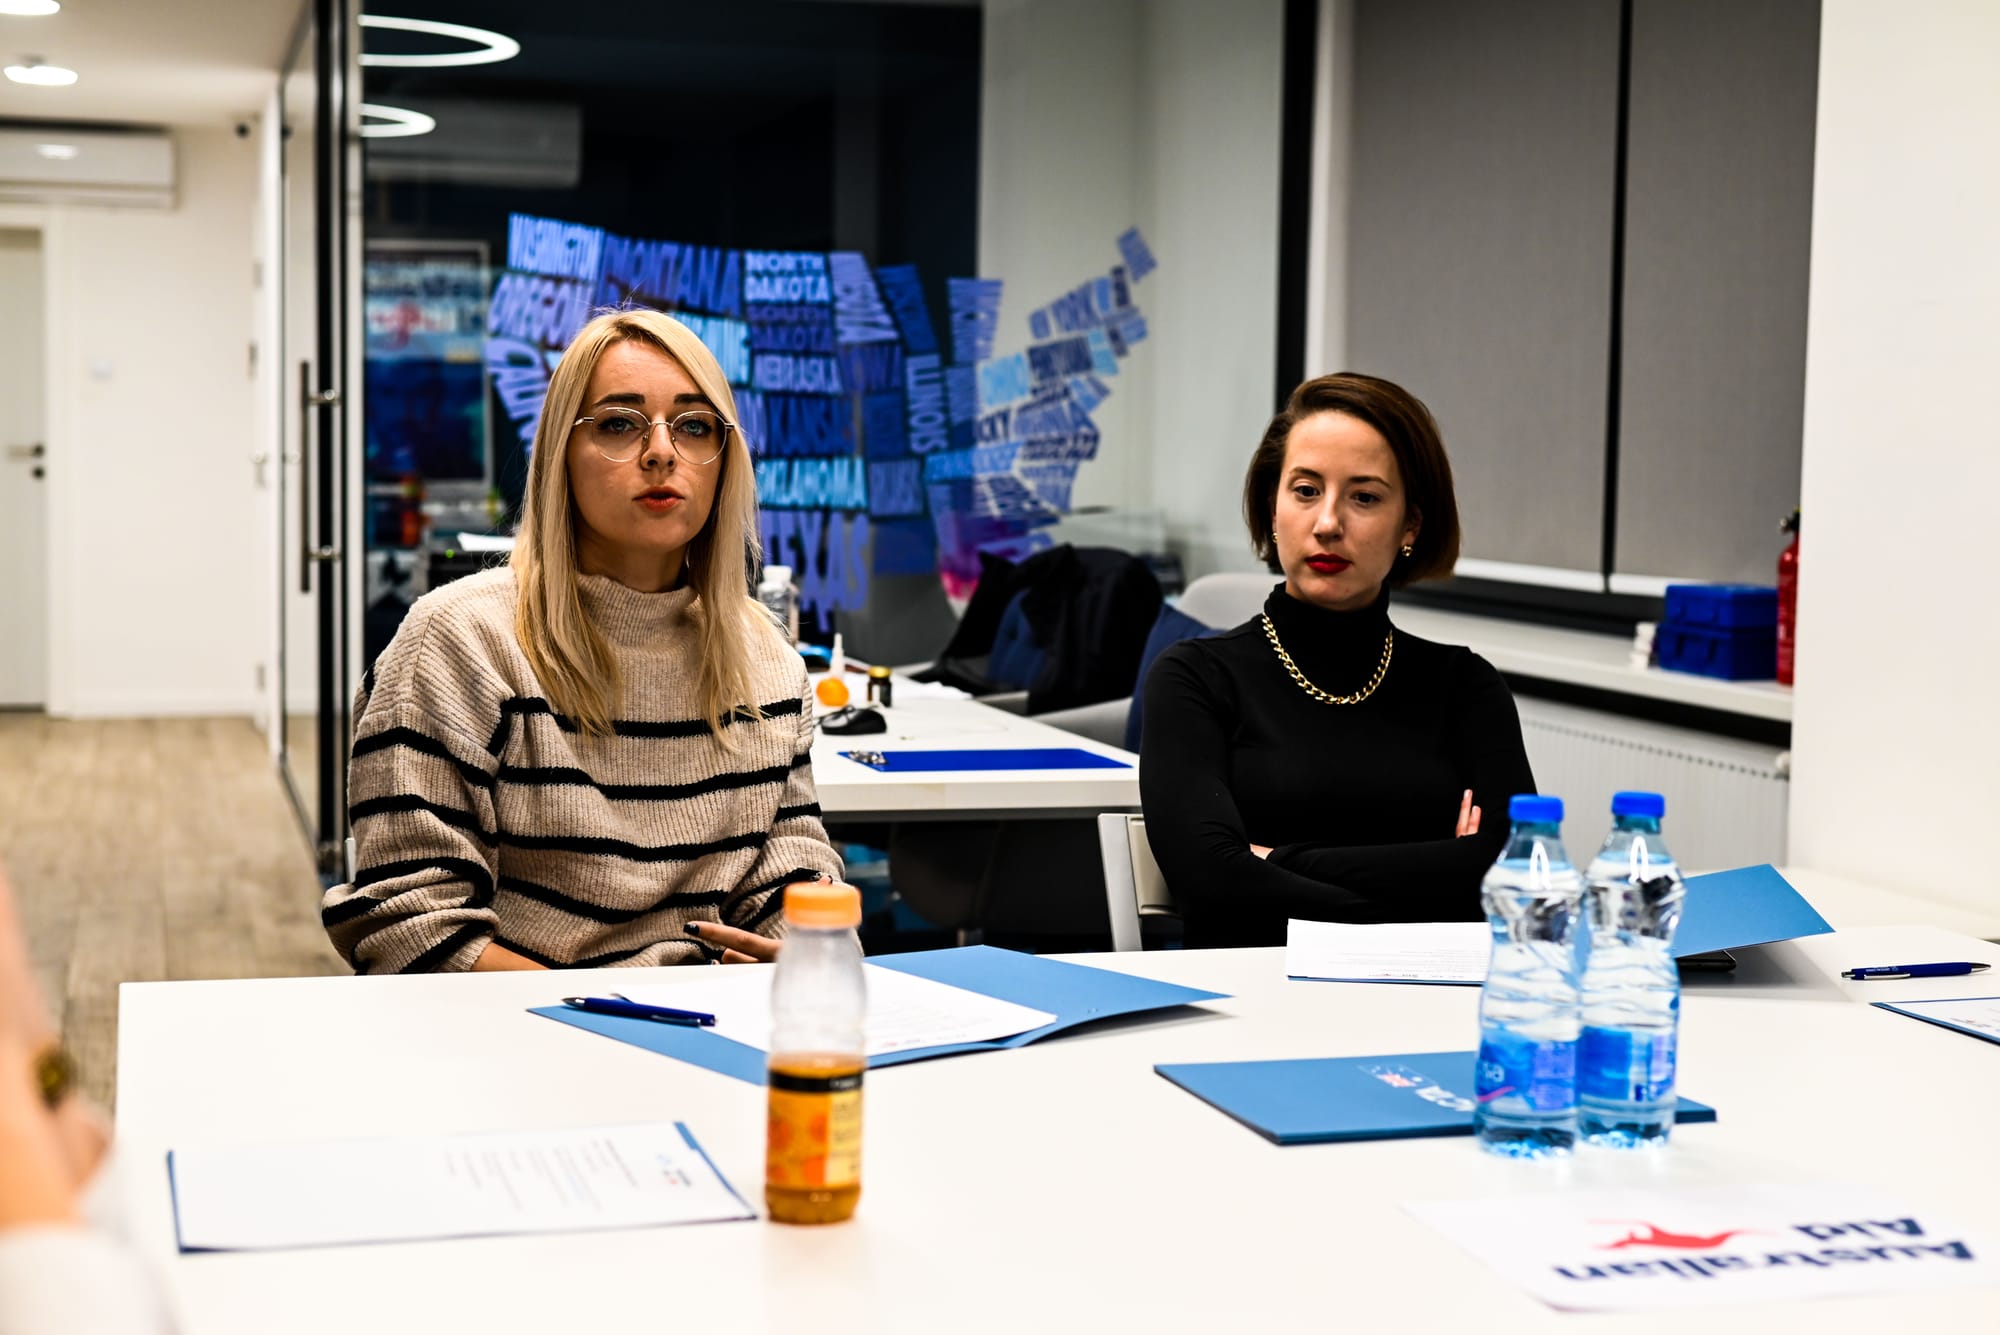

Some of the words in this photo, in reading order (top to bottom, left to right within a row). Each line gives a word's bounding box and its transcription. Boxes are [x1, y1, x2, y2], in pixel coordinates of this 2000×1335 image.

[508, 212, 604, 283] WASHINGTON
[745, 252, 825, 271] NORTH
[599, 231, 741, 318] MONTANA
[745, 275, 831, 302] DAKOTA
[487, 273, 595, 350] OREGON
[747, 303, 830, 323] SOUTH
[750, 325, 834, 351] DAKOTA
[752, 354, 845, 395] NEBRASKA
[907, 353, 949, 454] ILLINOIS
[758, 509, 871, 632] TEXAS
[1792, 1217, 1926, 1241] Aid
[1554, 1240, 1975, 1281] Australian
